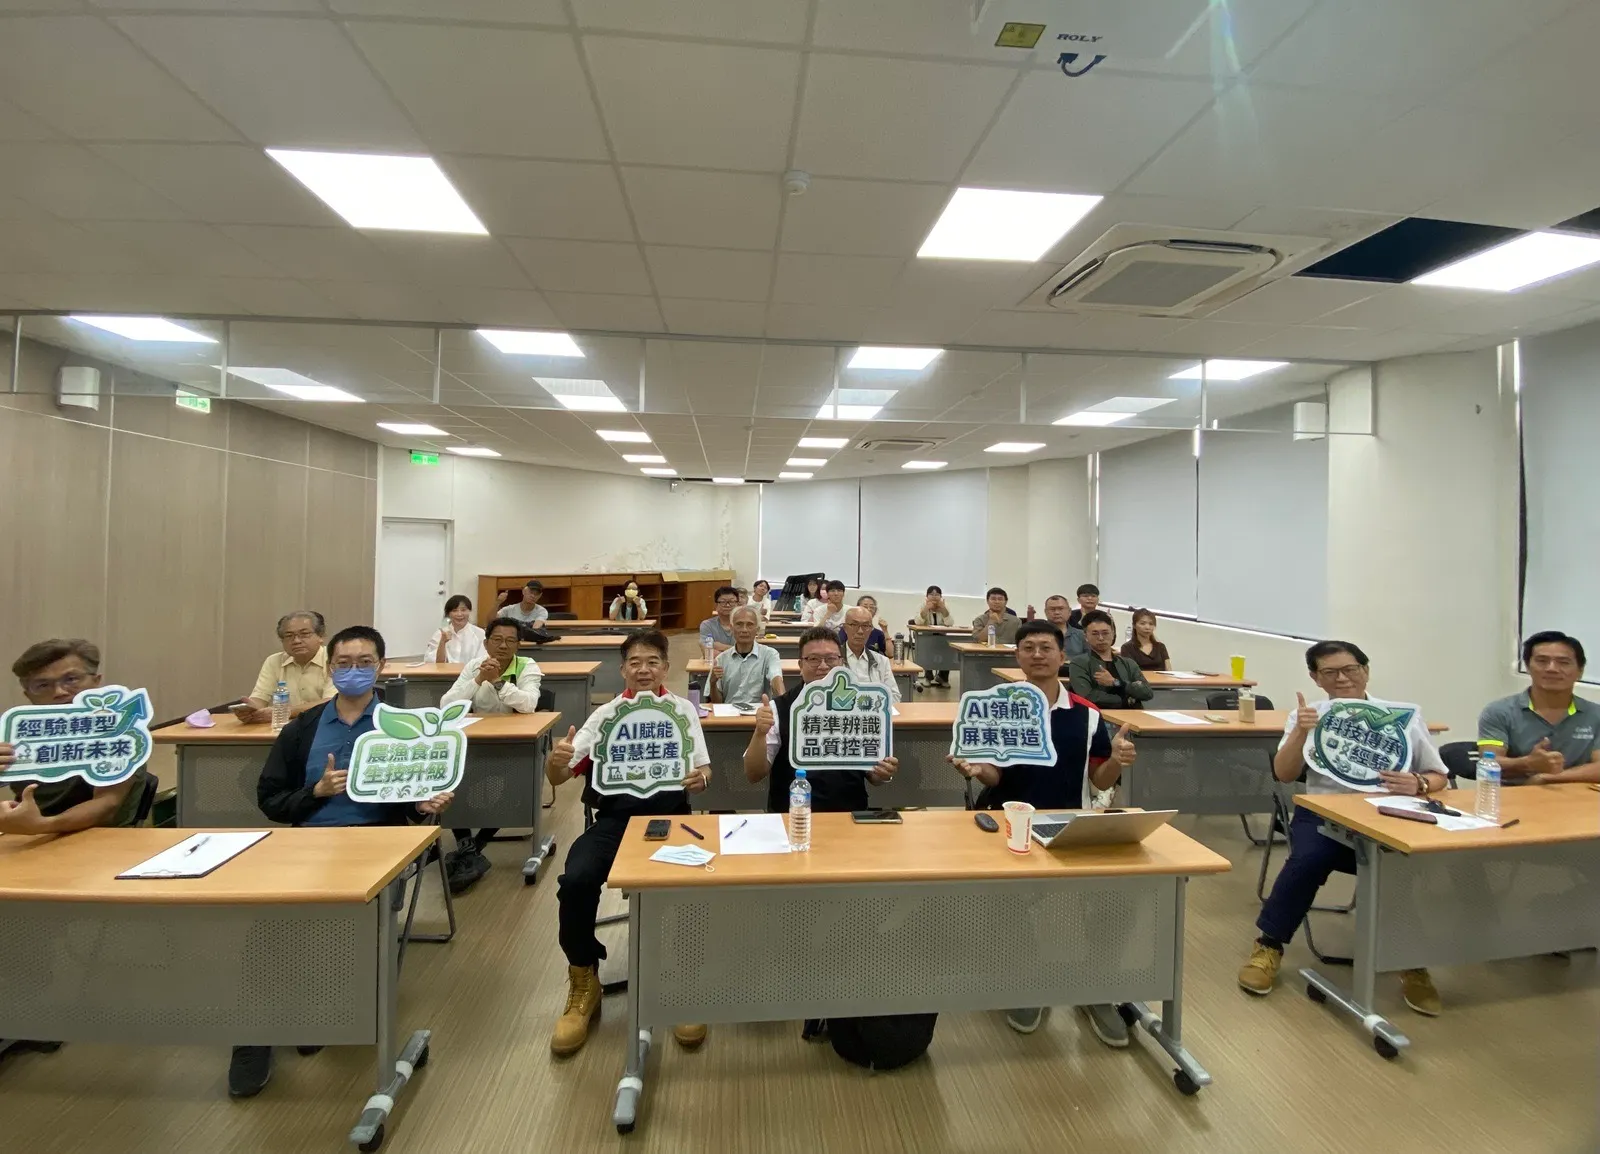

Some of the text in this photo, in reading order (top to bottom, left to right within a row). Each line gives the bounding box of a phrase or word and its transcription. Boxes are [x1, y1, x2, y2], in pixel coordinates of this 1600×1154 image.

[967, 701, 1030, 719] AI領航
[16, 715, 116, 738] 經驗轉型
[616, 720, 673, 740] AI賦能
[802, 715, 880, 734] 精準辨識
[802, 738, 880, 757] 品質控管
[962, 727, 1040, 746] 屏東智造
[1323, 715, 1403, 758] 科技傳承
[35, 739, 131, 764] 創新未來
[367, 741, 449, 763] 農漁食品
[610, 741, 679, 763] 智慧生產
[1347, 746, 1393, 772] 經驗
[362, 761, 448, 785] 生技升級
